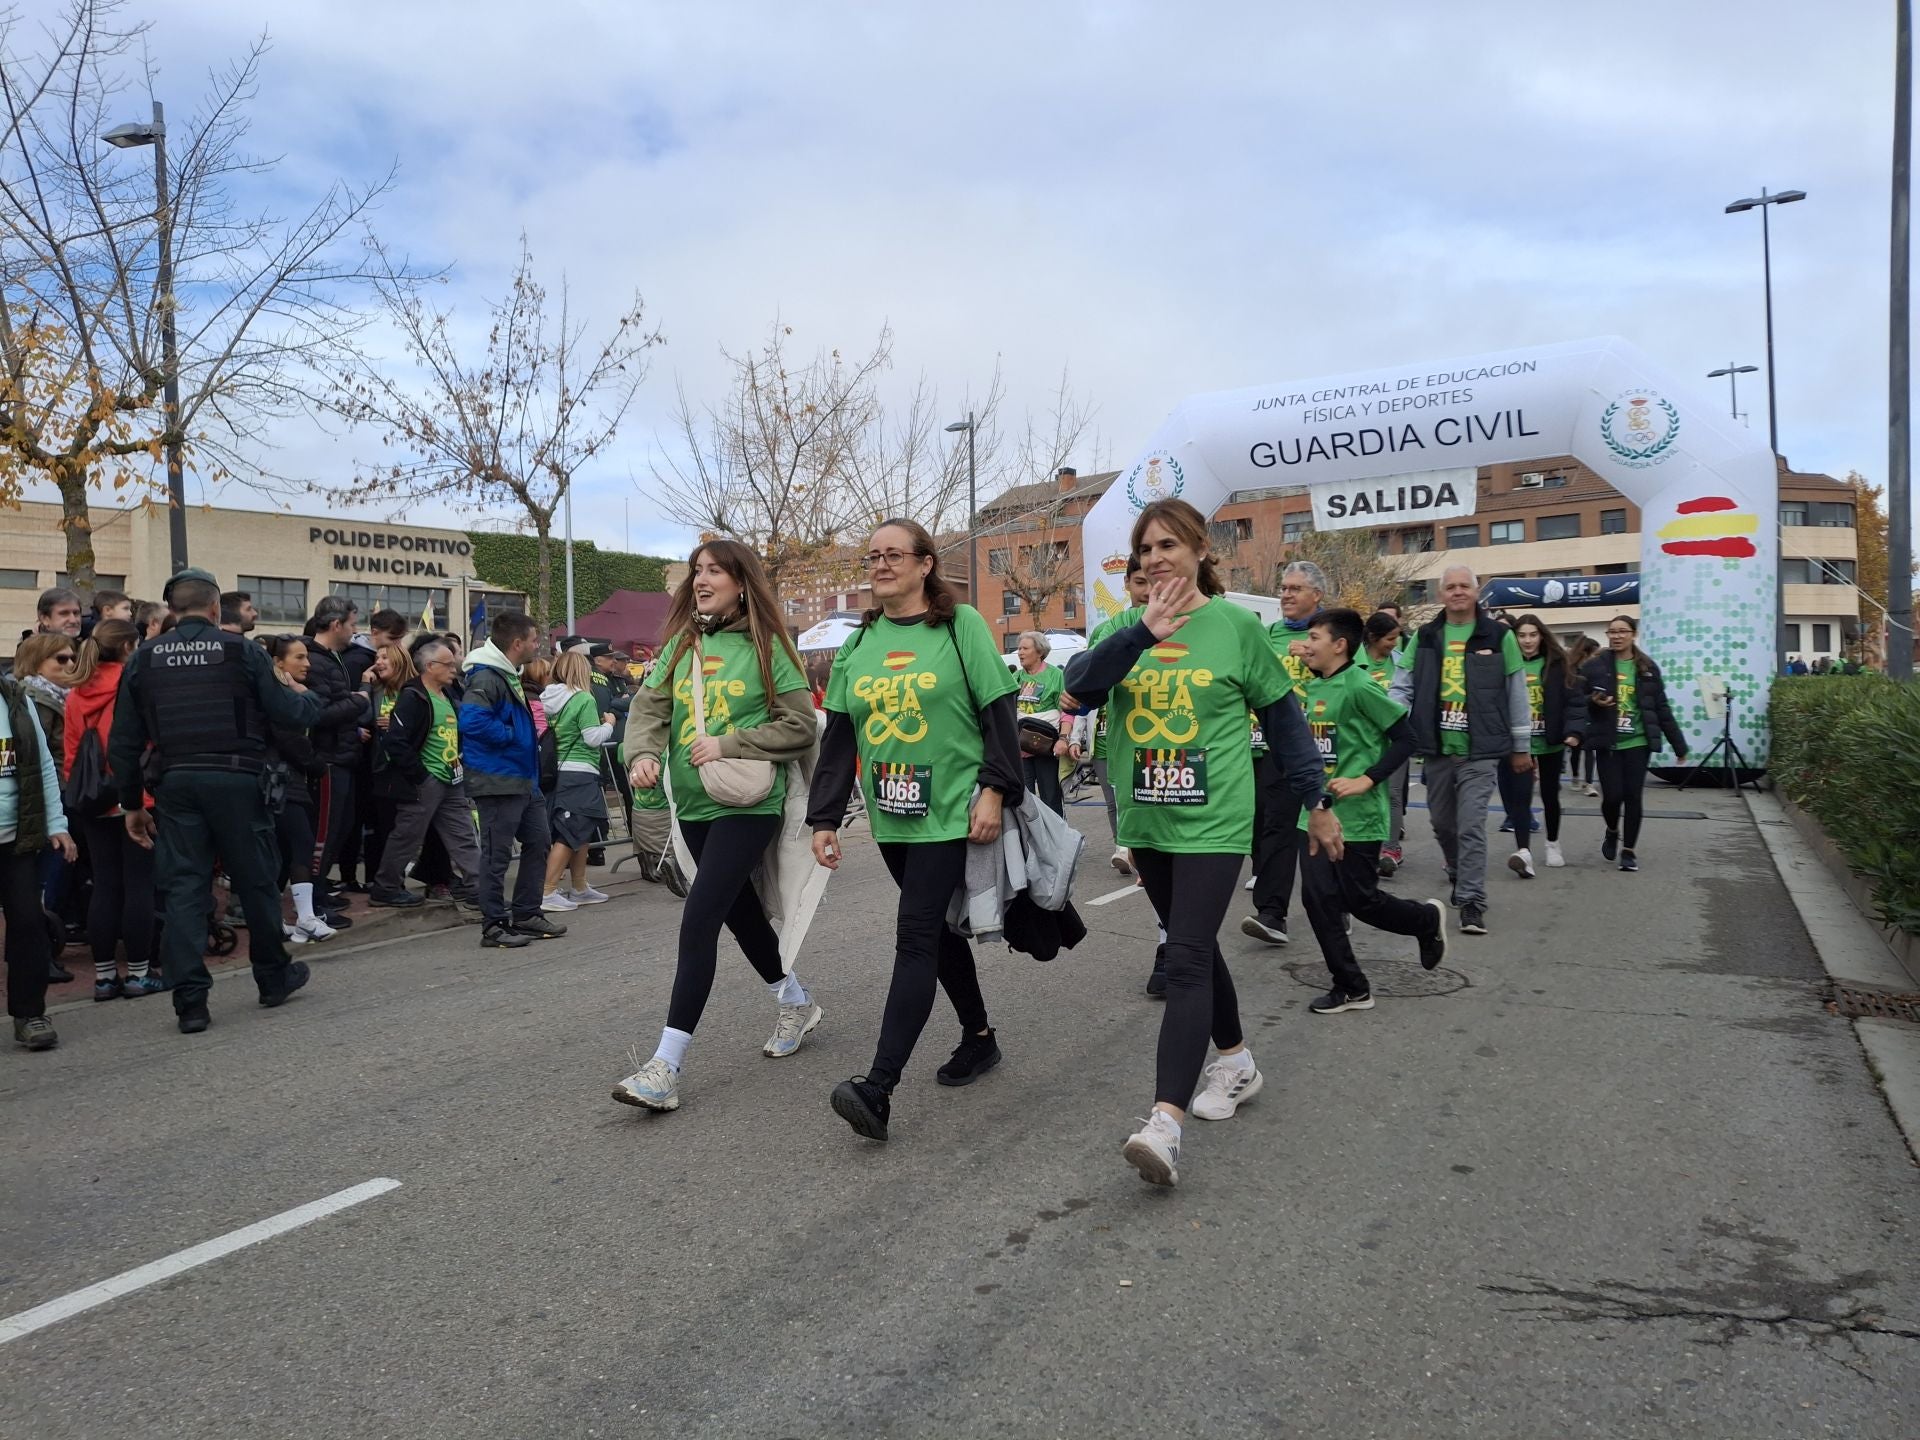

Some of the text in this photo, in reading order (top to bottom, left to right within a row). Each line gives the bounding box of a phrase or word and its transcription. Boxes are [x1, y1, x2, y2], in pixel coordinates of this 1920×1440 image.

[1252, 360, 1537, 412] JUNTA CENTRAL DE EDUCACIÓN
[1303, 388, 1473, 424] FÍSICA Y DEPORTES
[1250, 409, 1539, 469] GUARDIA CIVIL
[1326, 482, 1460, 518] SALIDA
[309, 527, 471, 556] POLIDEPORTIVO
[333, 554, 449, 578] MUNICIPAL
[1567, 581, 1601, 596] FFD
[153, 641, 223, 654] GUARDIA
[166, 654, 208, 667] CIVIL
[674, 678, 746, 700] Crre
[864, 687, 922, 714] TEA
[1128, 684, 1194, 710] TEA
[895, 710, 928, 726] AUTISMO
[1163, 708, 1199, 727] AUTISMO
[1141, 766, 1195, 789] 1326
[879, 778, 920, 802] 1068
[1137, 788, 1163, 796] CARRERA
[893, 800, 927, 808] SOLIDARIA
